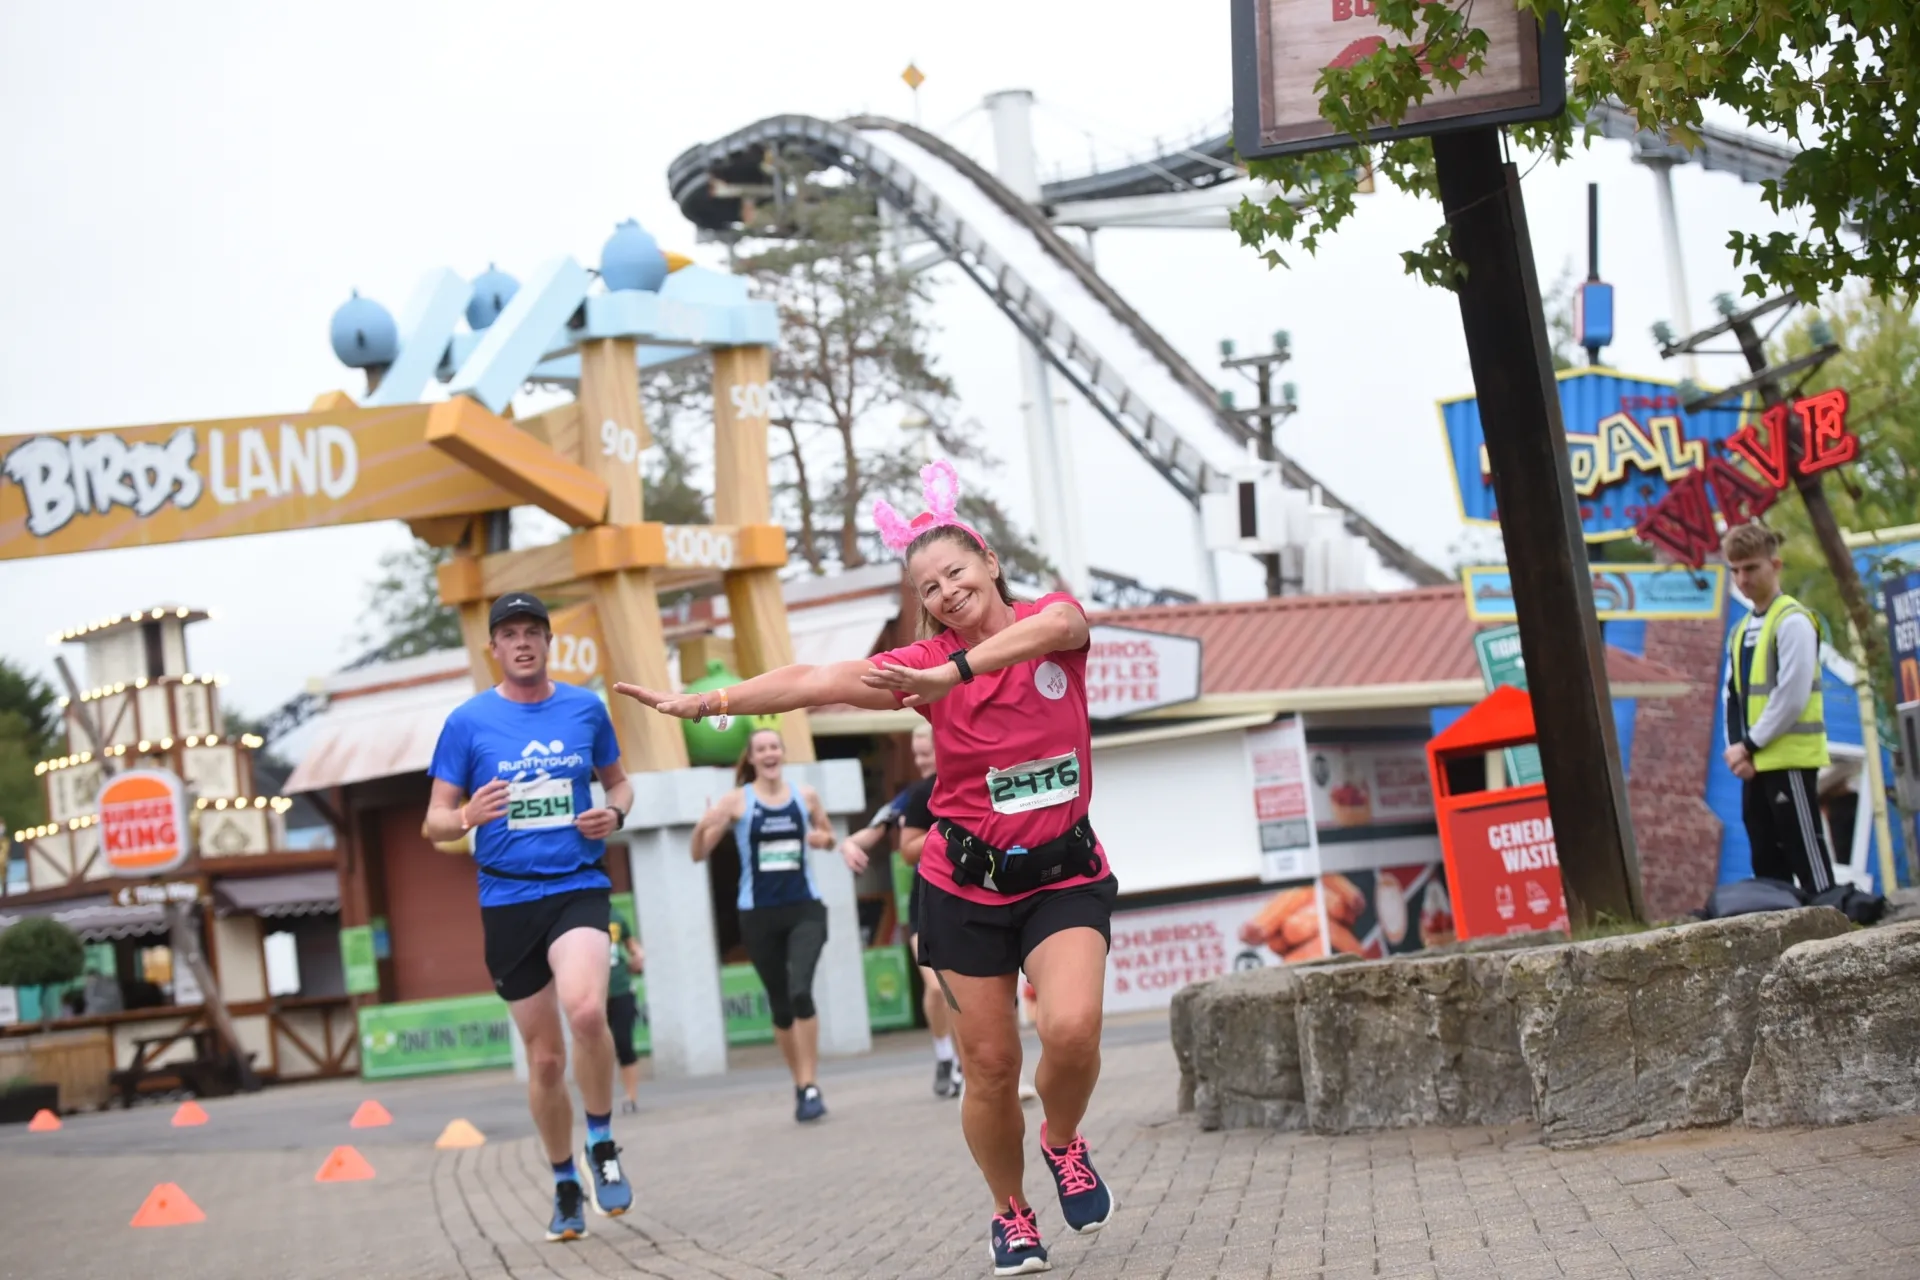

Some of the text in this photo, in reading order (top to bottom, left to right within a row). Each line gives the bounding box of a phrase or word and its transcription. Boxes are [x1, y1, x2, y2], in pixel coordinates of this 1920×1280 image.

[730, 381, 781, 418] 500
[602, 420, 638, 464] 90
[1, 424, 359, 537] BIRDS LAND
[1636, 387, 1859, 568] WAVE
[550, 633, 598, 675] 120
[1088, 661, 1159, 680] FFLES
[1087, 683, 1158, 702] OFFEE
[498, 753, 583, 774] RunThrough
[992, 760, 1078, 802] 2476
[102, 803, 173, 824] BURGER
[511, 796, 570, 819] 2514
[105, 822, 176, 851] KING
[1487, 816, 1555, 850] GENERA
[1113, 943, 1225, 969] WAFFLES
